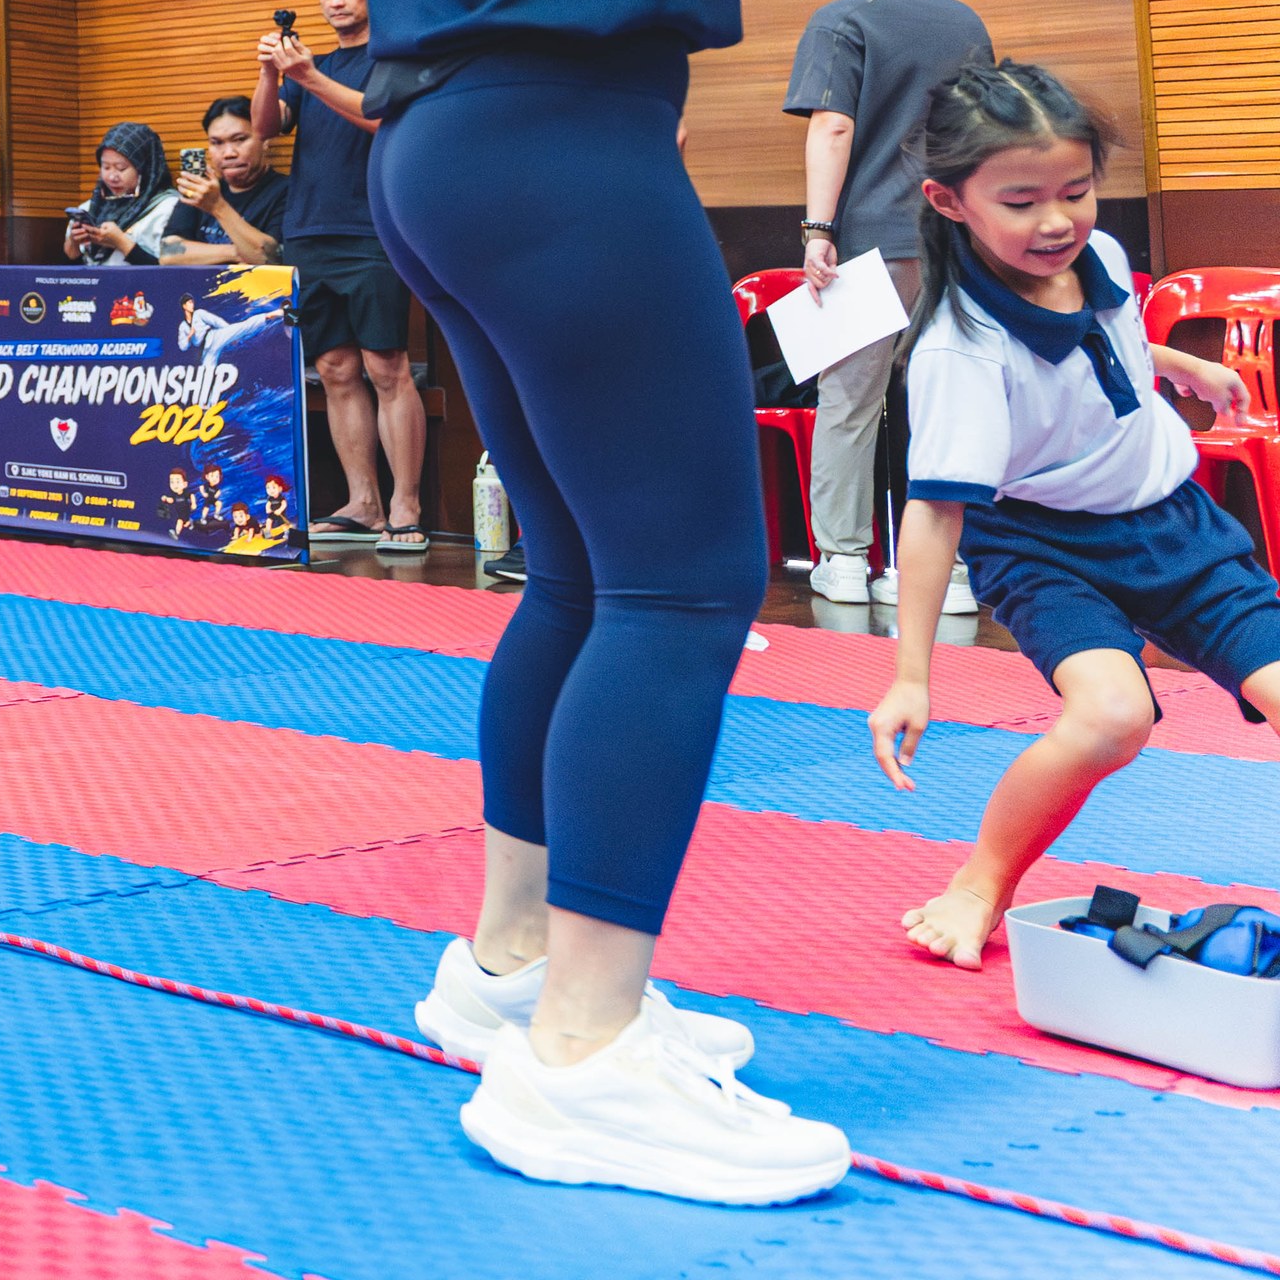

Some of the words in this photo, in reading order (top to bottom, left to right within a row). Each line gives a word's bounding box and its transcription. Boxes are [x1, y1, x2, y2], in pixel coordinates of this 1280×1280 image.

[15, 344, 39, 356] BELT
[40, 344, 99, 356] TAEKWONDO
[99, 343, 147, 356] ACADEMY
[18, 363, 239, 409] CHAMPIONSHIP
[129, 401, 229, 445] 2026
[78, 473, 103, 483] SCHOOL
[103, 476, 121, 485] HALL
